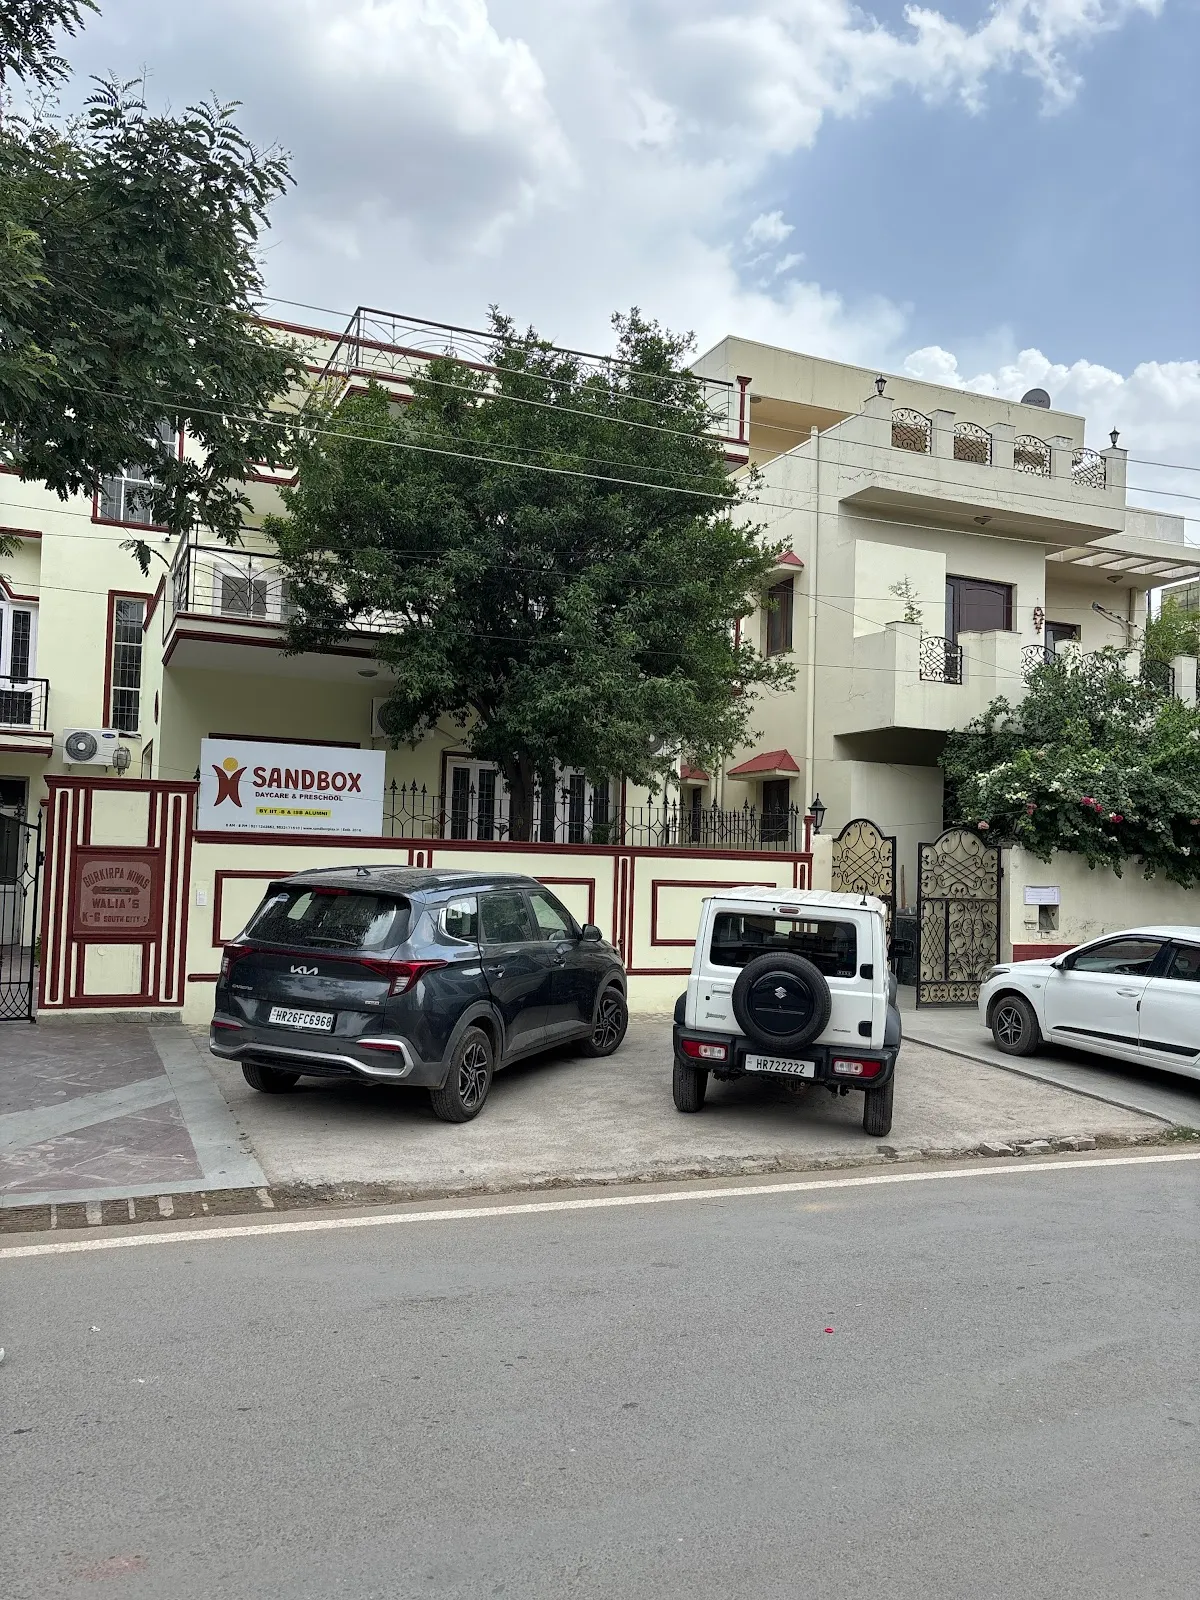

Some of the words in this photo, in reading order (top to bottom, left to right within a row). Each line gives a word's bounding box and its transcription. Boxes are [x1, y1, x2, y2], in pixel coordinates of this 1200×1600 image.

[252, 766, 362, 793] SANDBOX
[255, 791, 289, 799] DAYCARE
[299, 793, 343, 801] PRESCHOOL
[82, 867, 125, 888] GURKIRPA
[126, 869, 150, 890] NIWAS
[92, 897, 140, 909] WALIA'S
[103, 915, 125, 923] SOUTH
[290, 964, 319, 976] KIA
[275, 1009, 332, 1028] HR26FC6968
[756, 1058, 806, 1075] HR722222
